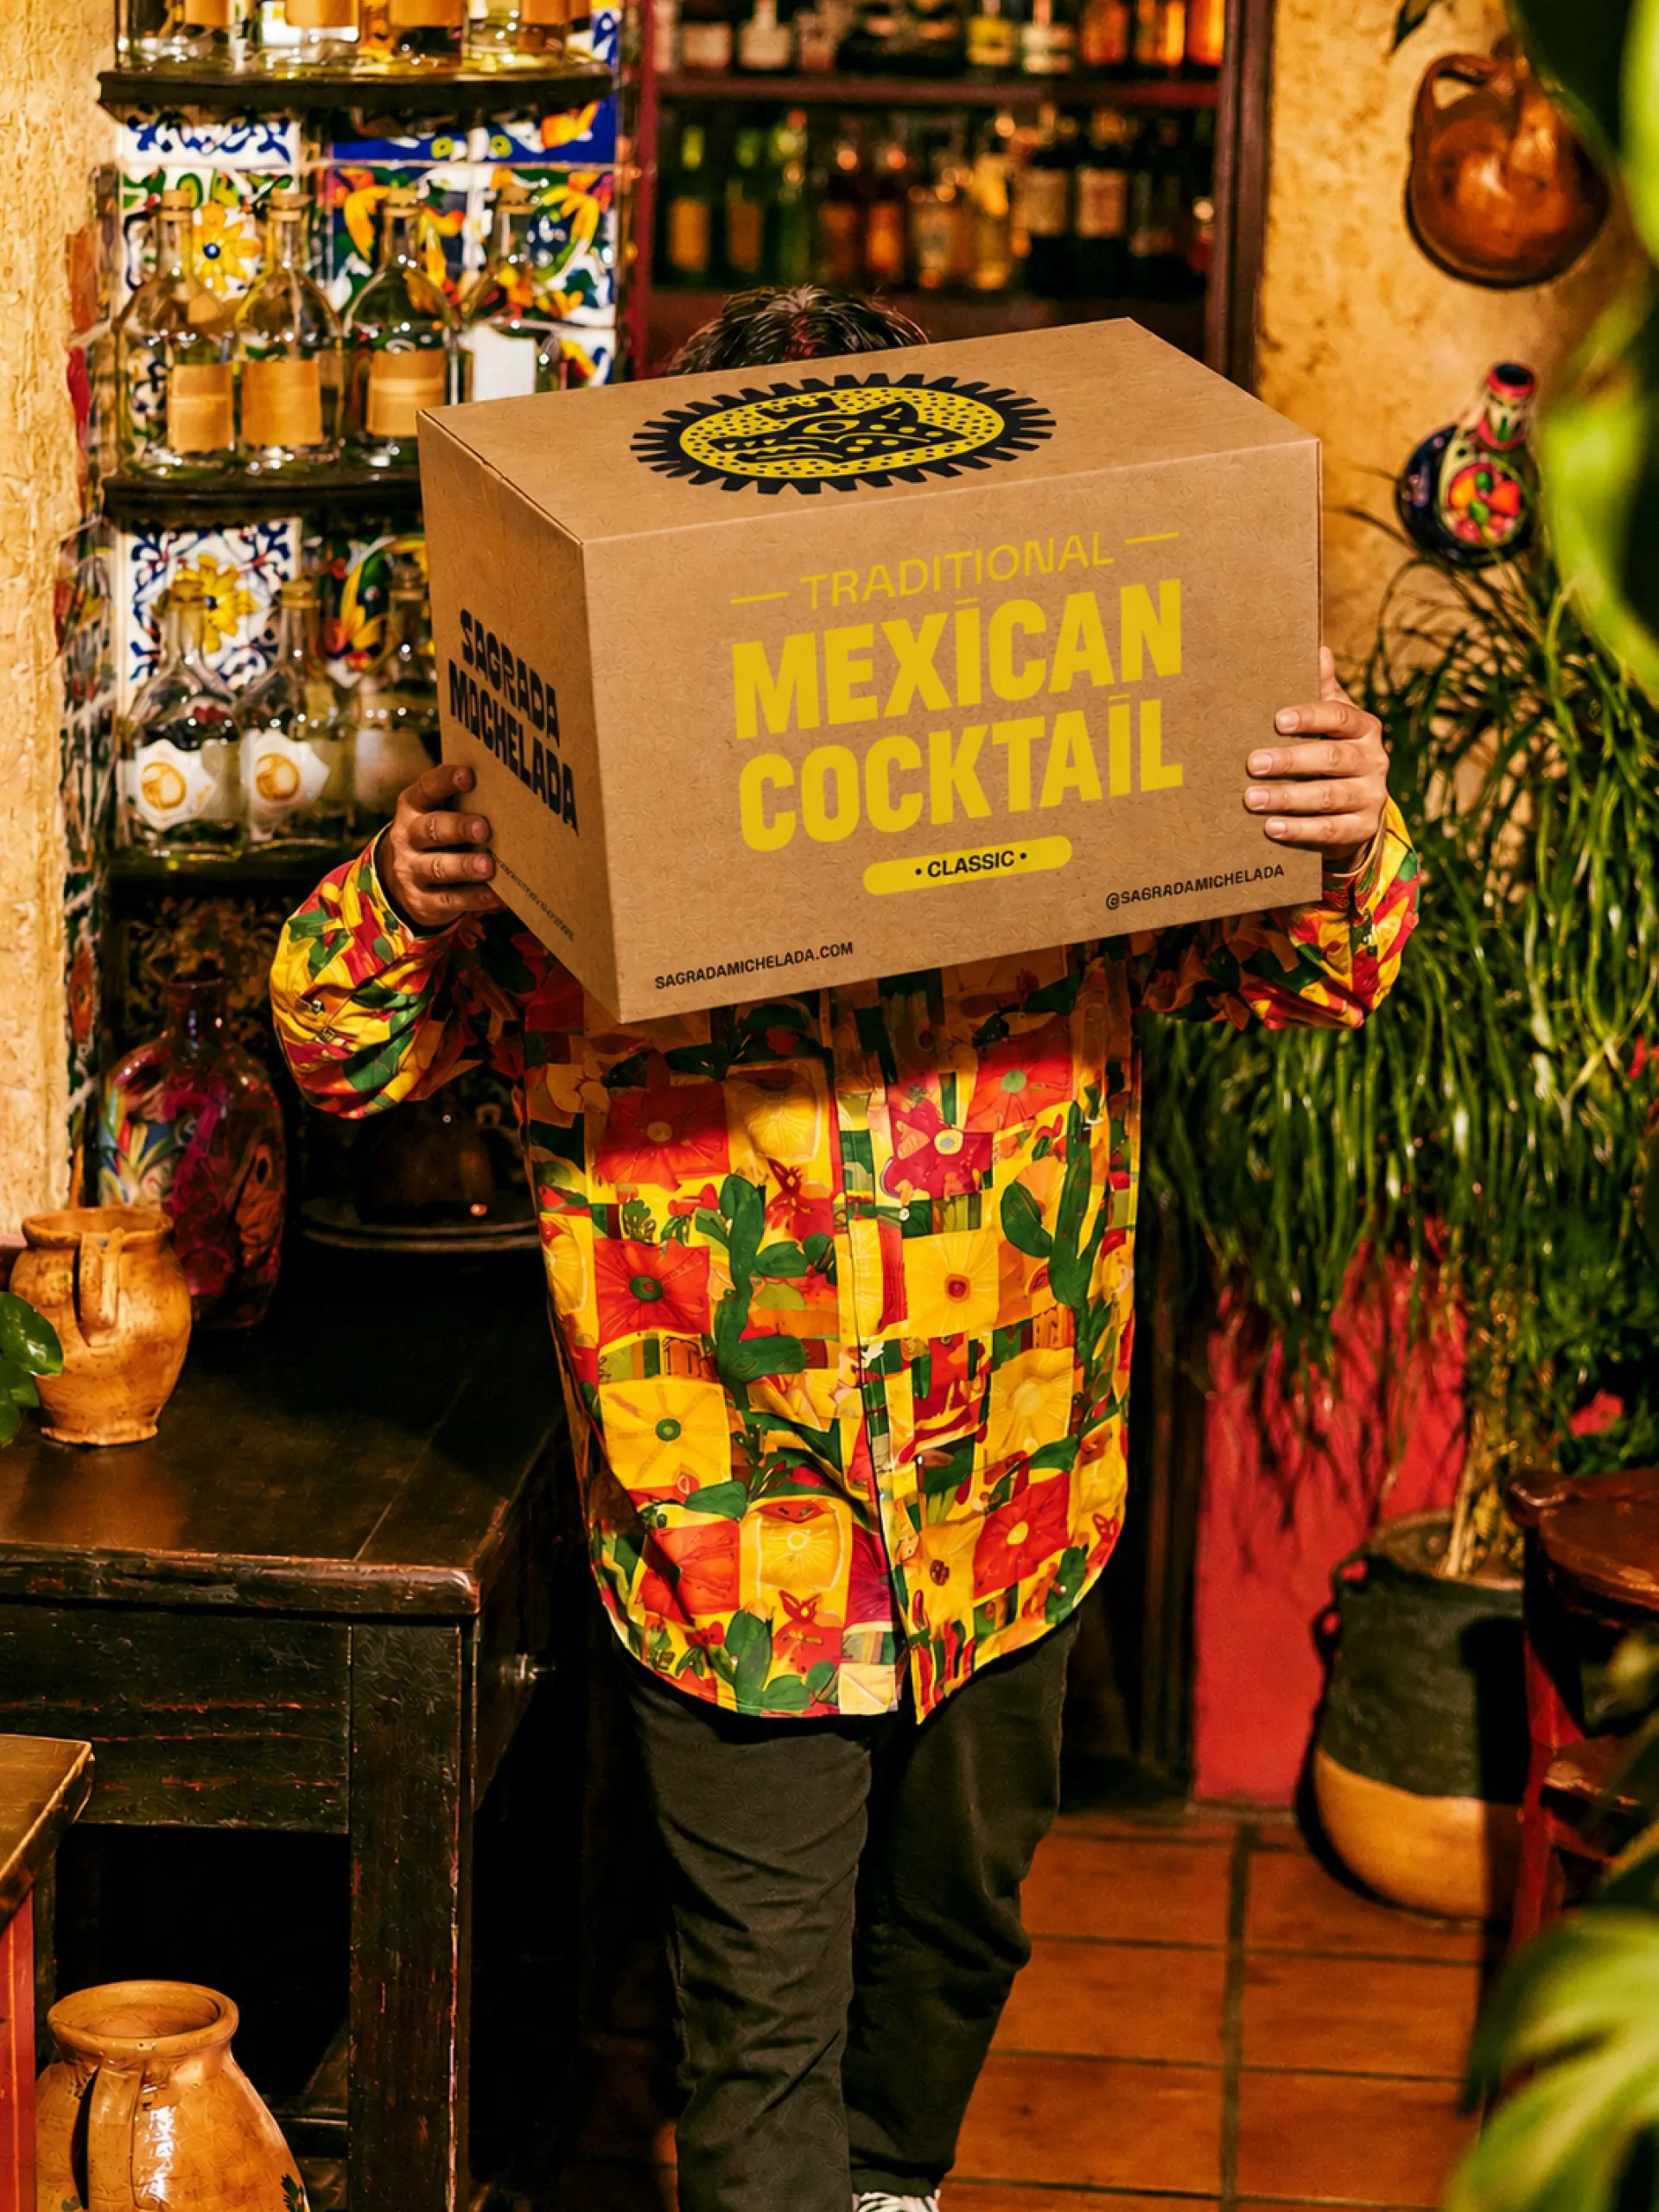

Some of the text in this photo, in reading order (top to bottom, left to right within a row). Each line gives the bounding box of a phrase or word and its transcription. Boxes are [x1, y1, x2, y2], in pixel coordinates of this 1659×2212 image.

[800, 531, 1115, 610] TRADITIONAL
[460, 608, 560, 748] SAGRADA
[654, 941, 854, 989] SAGRADAMICHELADA.COM
